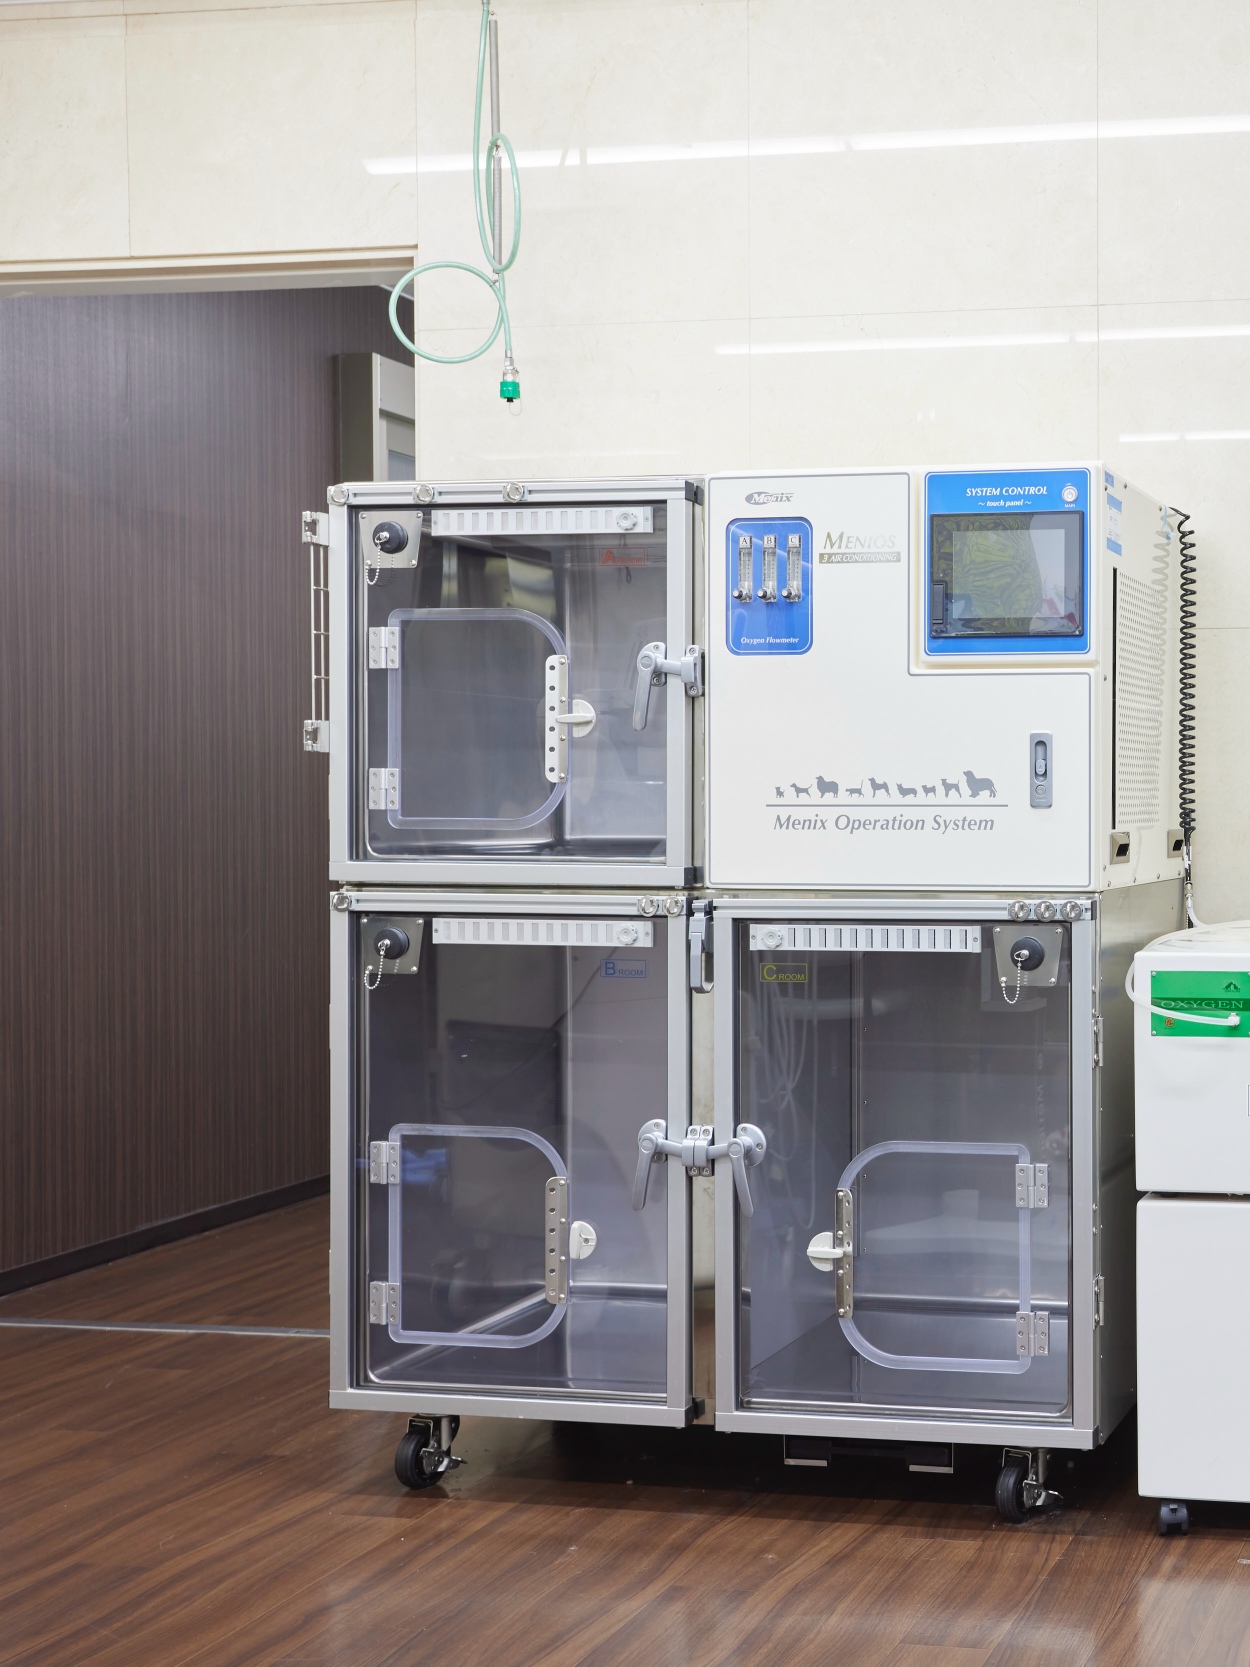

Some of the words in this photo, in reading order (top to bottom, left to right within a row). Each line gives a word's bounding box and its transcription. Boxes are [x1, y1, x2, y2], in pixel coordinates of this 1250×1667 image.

[965, 487, 1001, 496] SYSTEM
[1002, 486, 1048, 495] CONTROL
[748, 492, 794, 504] Menix
[1005, 499, 1024, 508] panel
[741, 537, 748, 545] A
[766, 536, 773, 544] B
[790, 536, 797, 544] C
[823, 531, 897, 550] MENIOS
[602, 549, 615, 564] A
[821, 554, 828, 562] 3
[829, 554, 842, 562] AIR
[842, 553, 898, 562] CONDITIONING
[740, 636, 765, 645] Oxygen
[765, 636, 800, 644] Flowmeter
[774, 814, 827, 831] Menix
[834, 814, 926, 835] Operation
[931, 814, 995, 835] System
[605, 961, 616, 976] B
[763, 965, 777, 980] C
[778, 973, 805, 981] ROOM
[1160, 1000, 1244, 1009] OXYGEN
